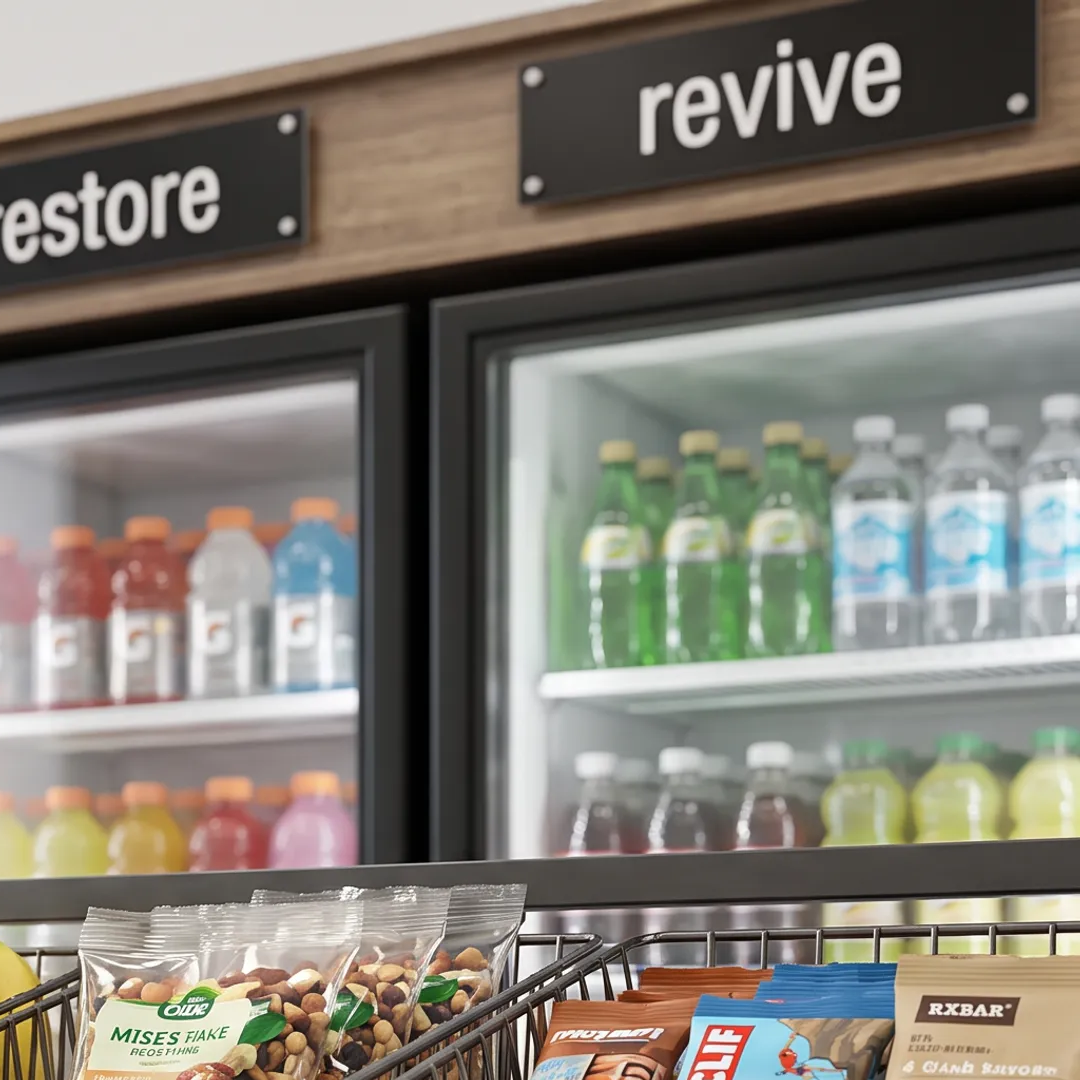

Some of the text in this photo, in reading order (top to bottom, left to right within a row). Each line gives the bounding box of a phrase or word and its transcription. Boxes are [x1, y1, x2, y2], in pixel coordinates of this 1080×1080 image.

[639, 38, 902, 156] revive
[927, 1002, 1005, 1018] RXBAR
[110, 1026, 181, 1046] MISES
